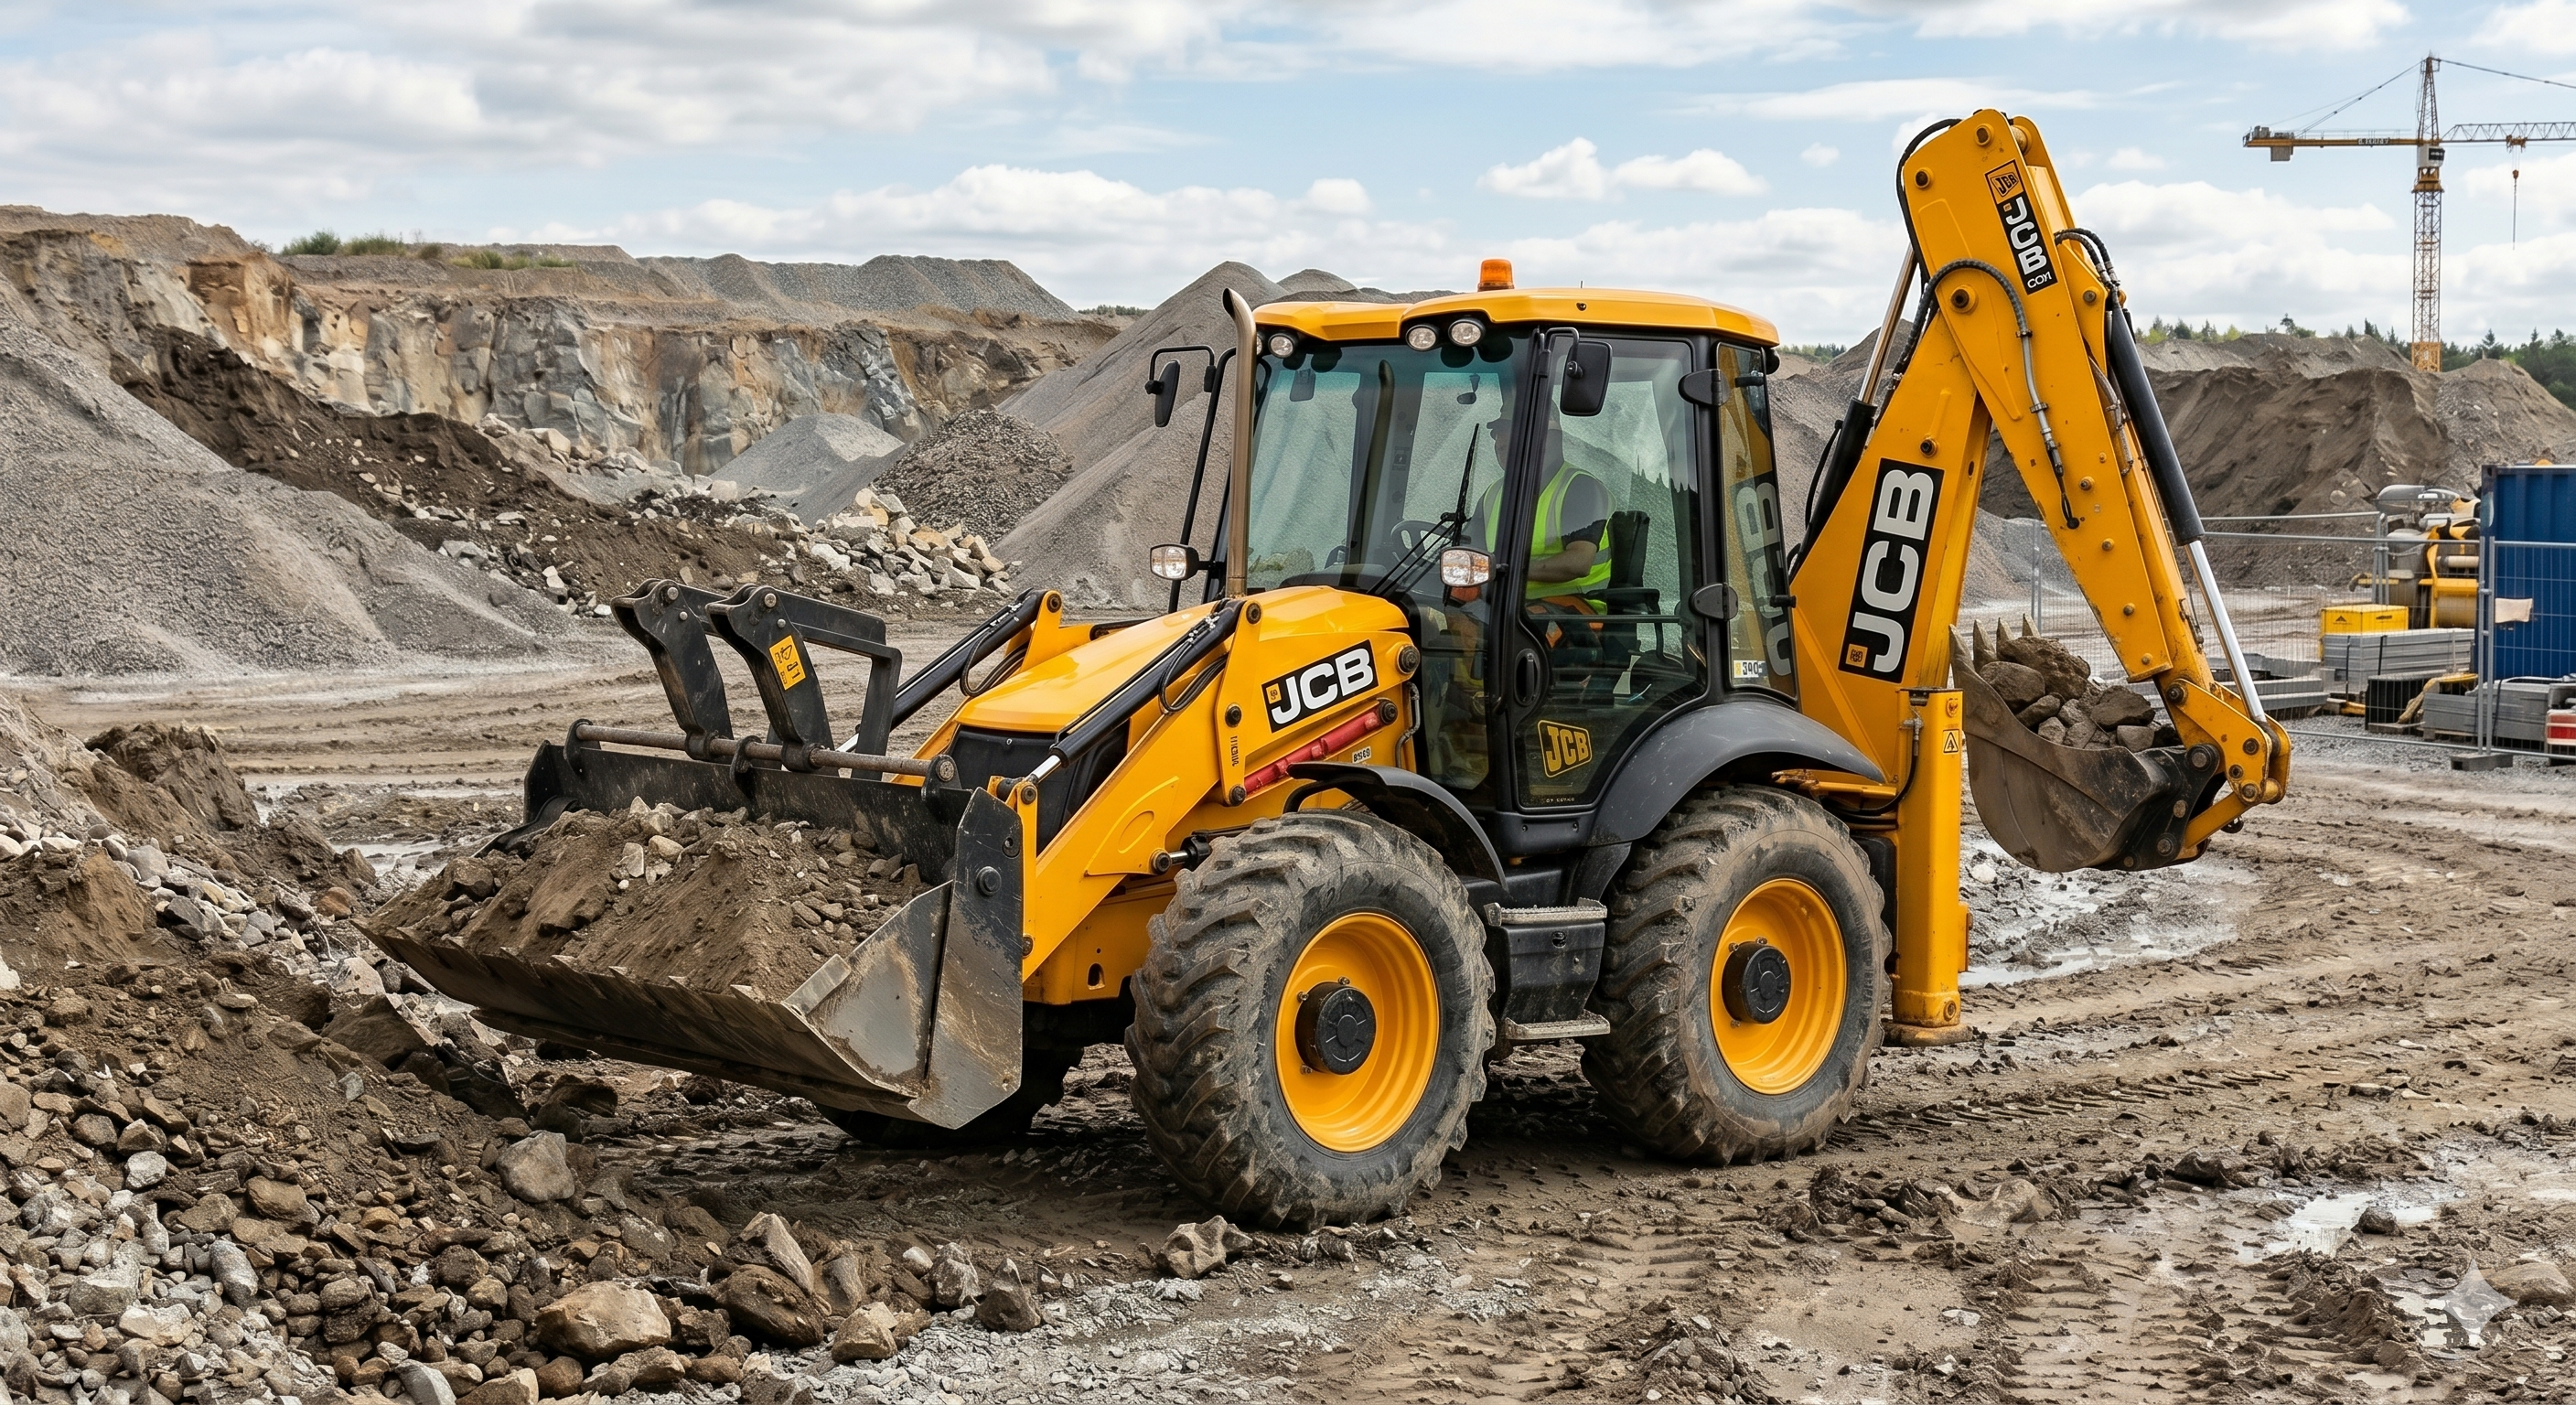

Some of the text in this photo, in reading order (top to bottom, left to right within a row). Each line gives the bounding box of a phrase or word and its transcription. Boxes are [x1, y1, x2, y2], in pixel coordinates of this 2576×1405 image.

[2005, 196, 2047, 275] JCB
[1852, 469, 1934, 673] JCB
[1271, 648, 1374, 724] JCB
[1546, 725, 1589, 772] JCB
